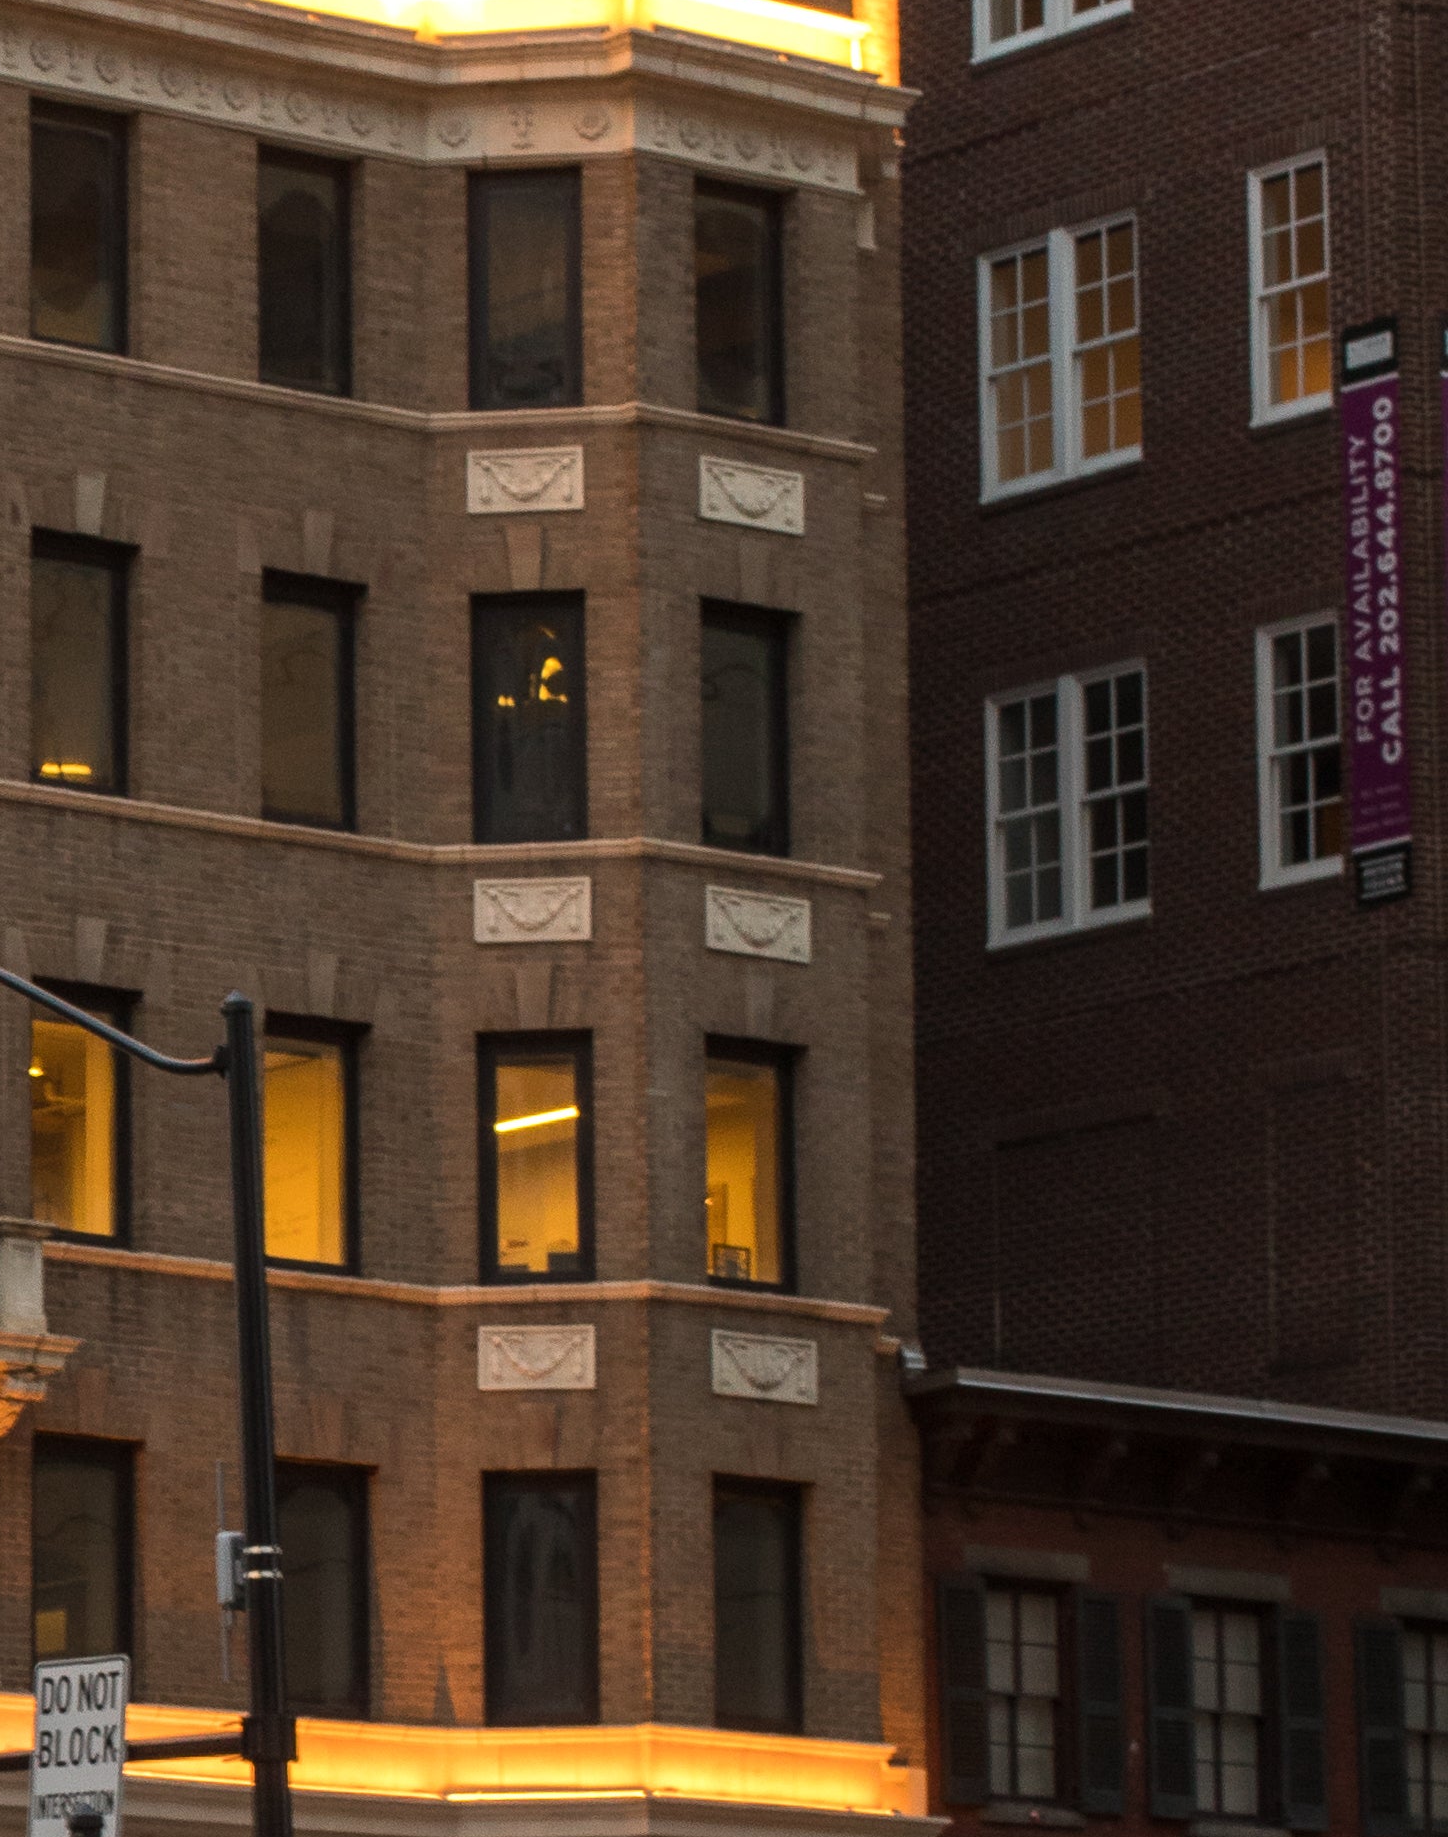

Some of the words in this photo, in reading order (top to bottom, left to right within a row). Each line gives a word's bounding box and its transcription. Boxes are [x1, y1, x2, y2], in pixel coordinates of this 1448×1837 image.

[1348, 434, 1372, 662] AVAILABILITY
[1372, 396, 1401, 656] 202.644.8700
[1355, 675, 1375, 743] FOR
[1380, 665, 1402, 764] CALL
[41, 1675, 71, 1714] DO
[77, 1671, 120, 1712] NOT
[38, 1724, 118, 1768] BLOCK
